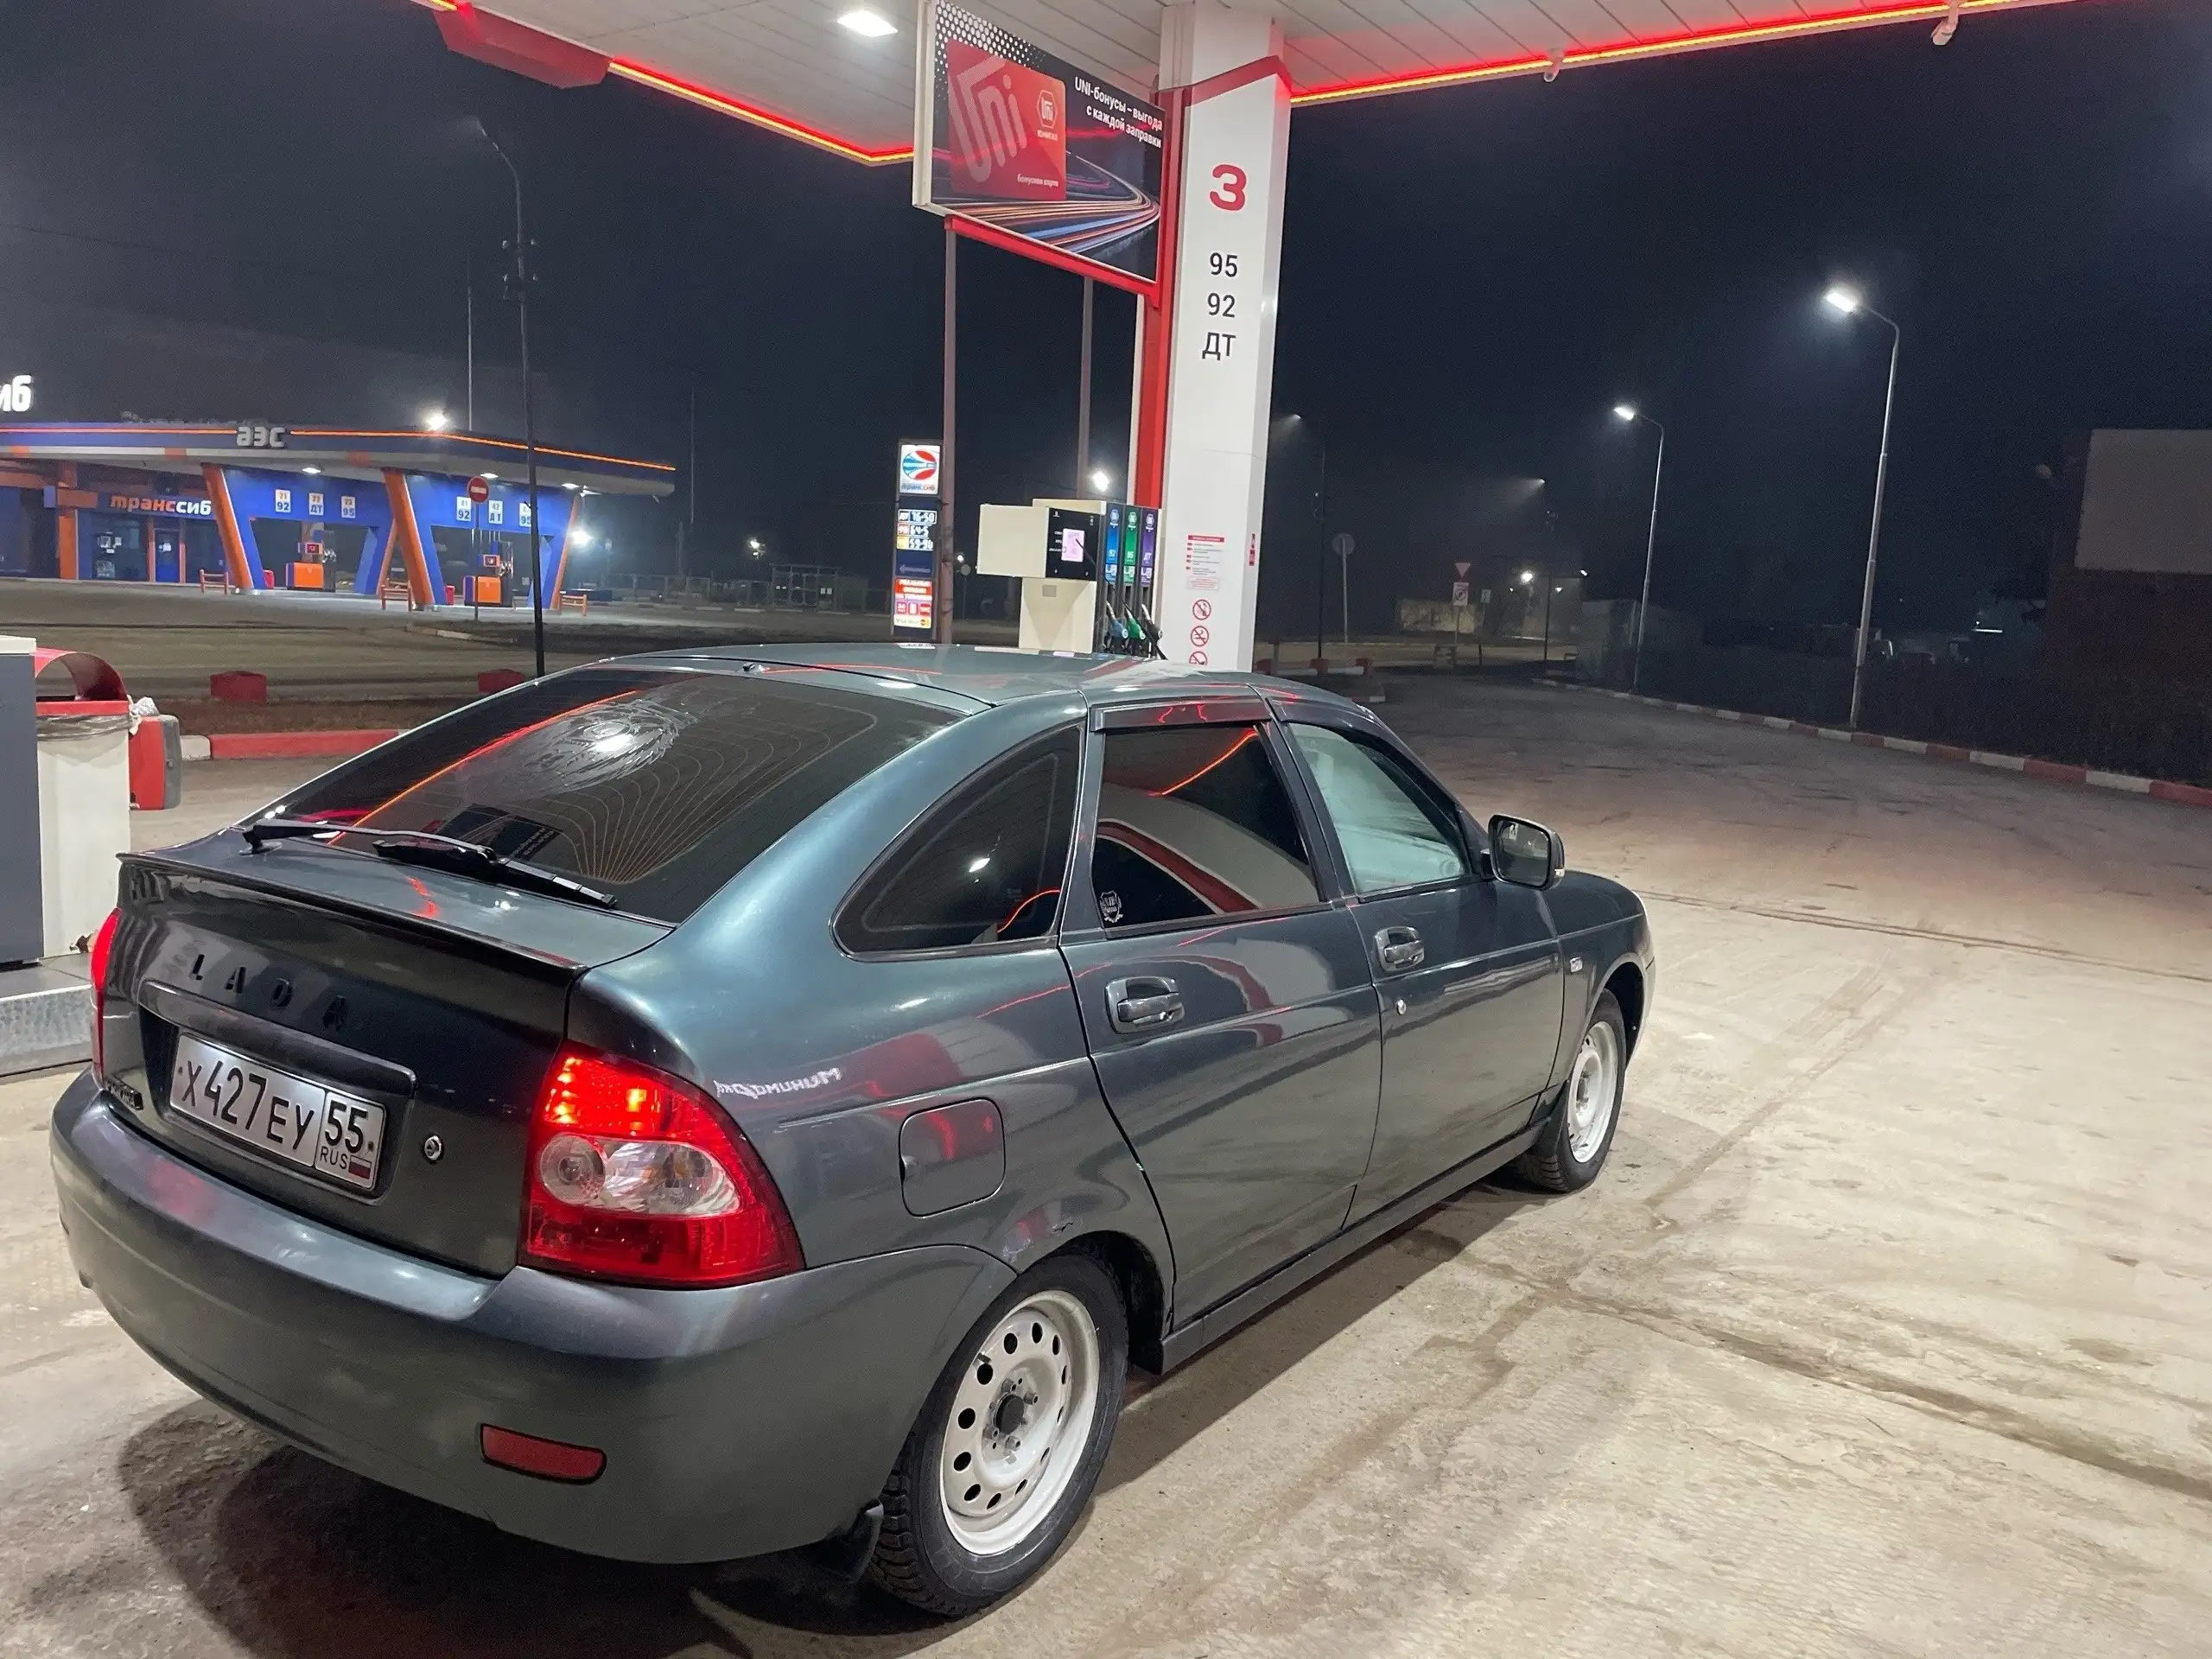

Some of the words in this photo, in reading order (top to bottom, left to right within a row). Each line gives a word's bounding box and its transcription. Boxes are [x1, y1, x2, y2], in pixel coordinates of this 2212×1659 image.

[1075, 76, 1126, 113] UNI-бонусы
[1133, 108, 1162, 131] выгода
[1086, 105, 1092, 116] с
[1093, 108, 1125, 130] каждой
[1126, 124, 1161, 149] заправки
[1210, 164, 1247, 211] 3
[1210, 252, 1237, 277] 95
[1207, 292, 1236, 318] 92
[1202, 332, 1236, 360] ДТ
[111, 495, 212, 515] транссиб
[276, 502, 289, 511] 92
[311, 505, 322, 513] ДТ
[343, 508, 355, 517] 95
[458, 510, 470, 519] 92
[188, 954, 346, 1032] LADA
[325, 1099, 367, 1154] 55
[321, 1146, 347, 1170] RUS
